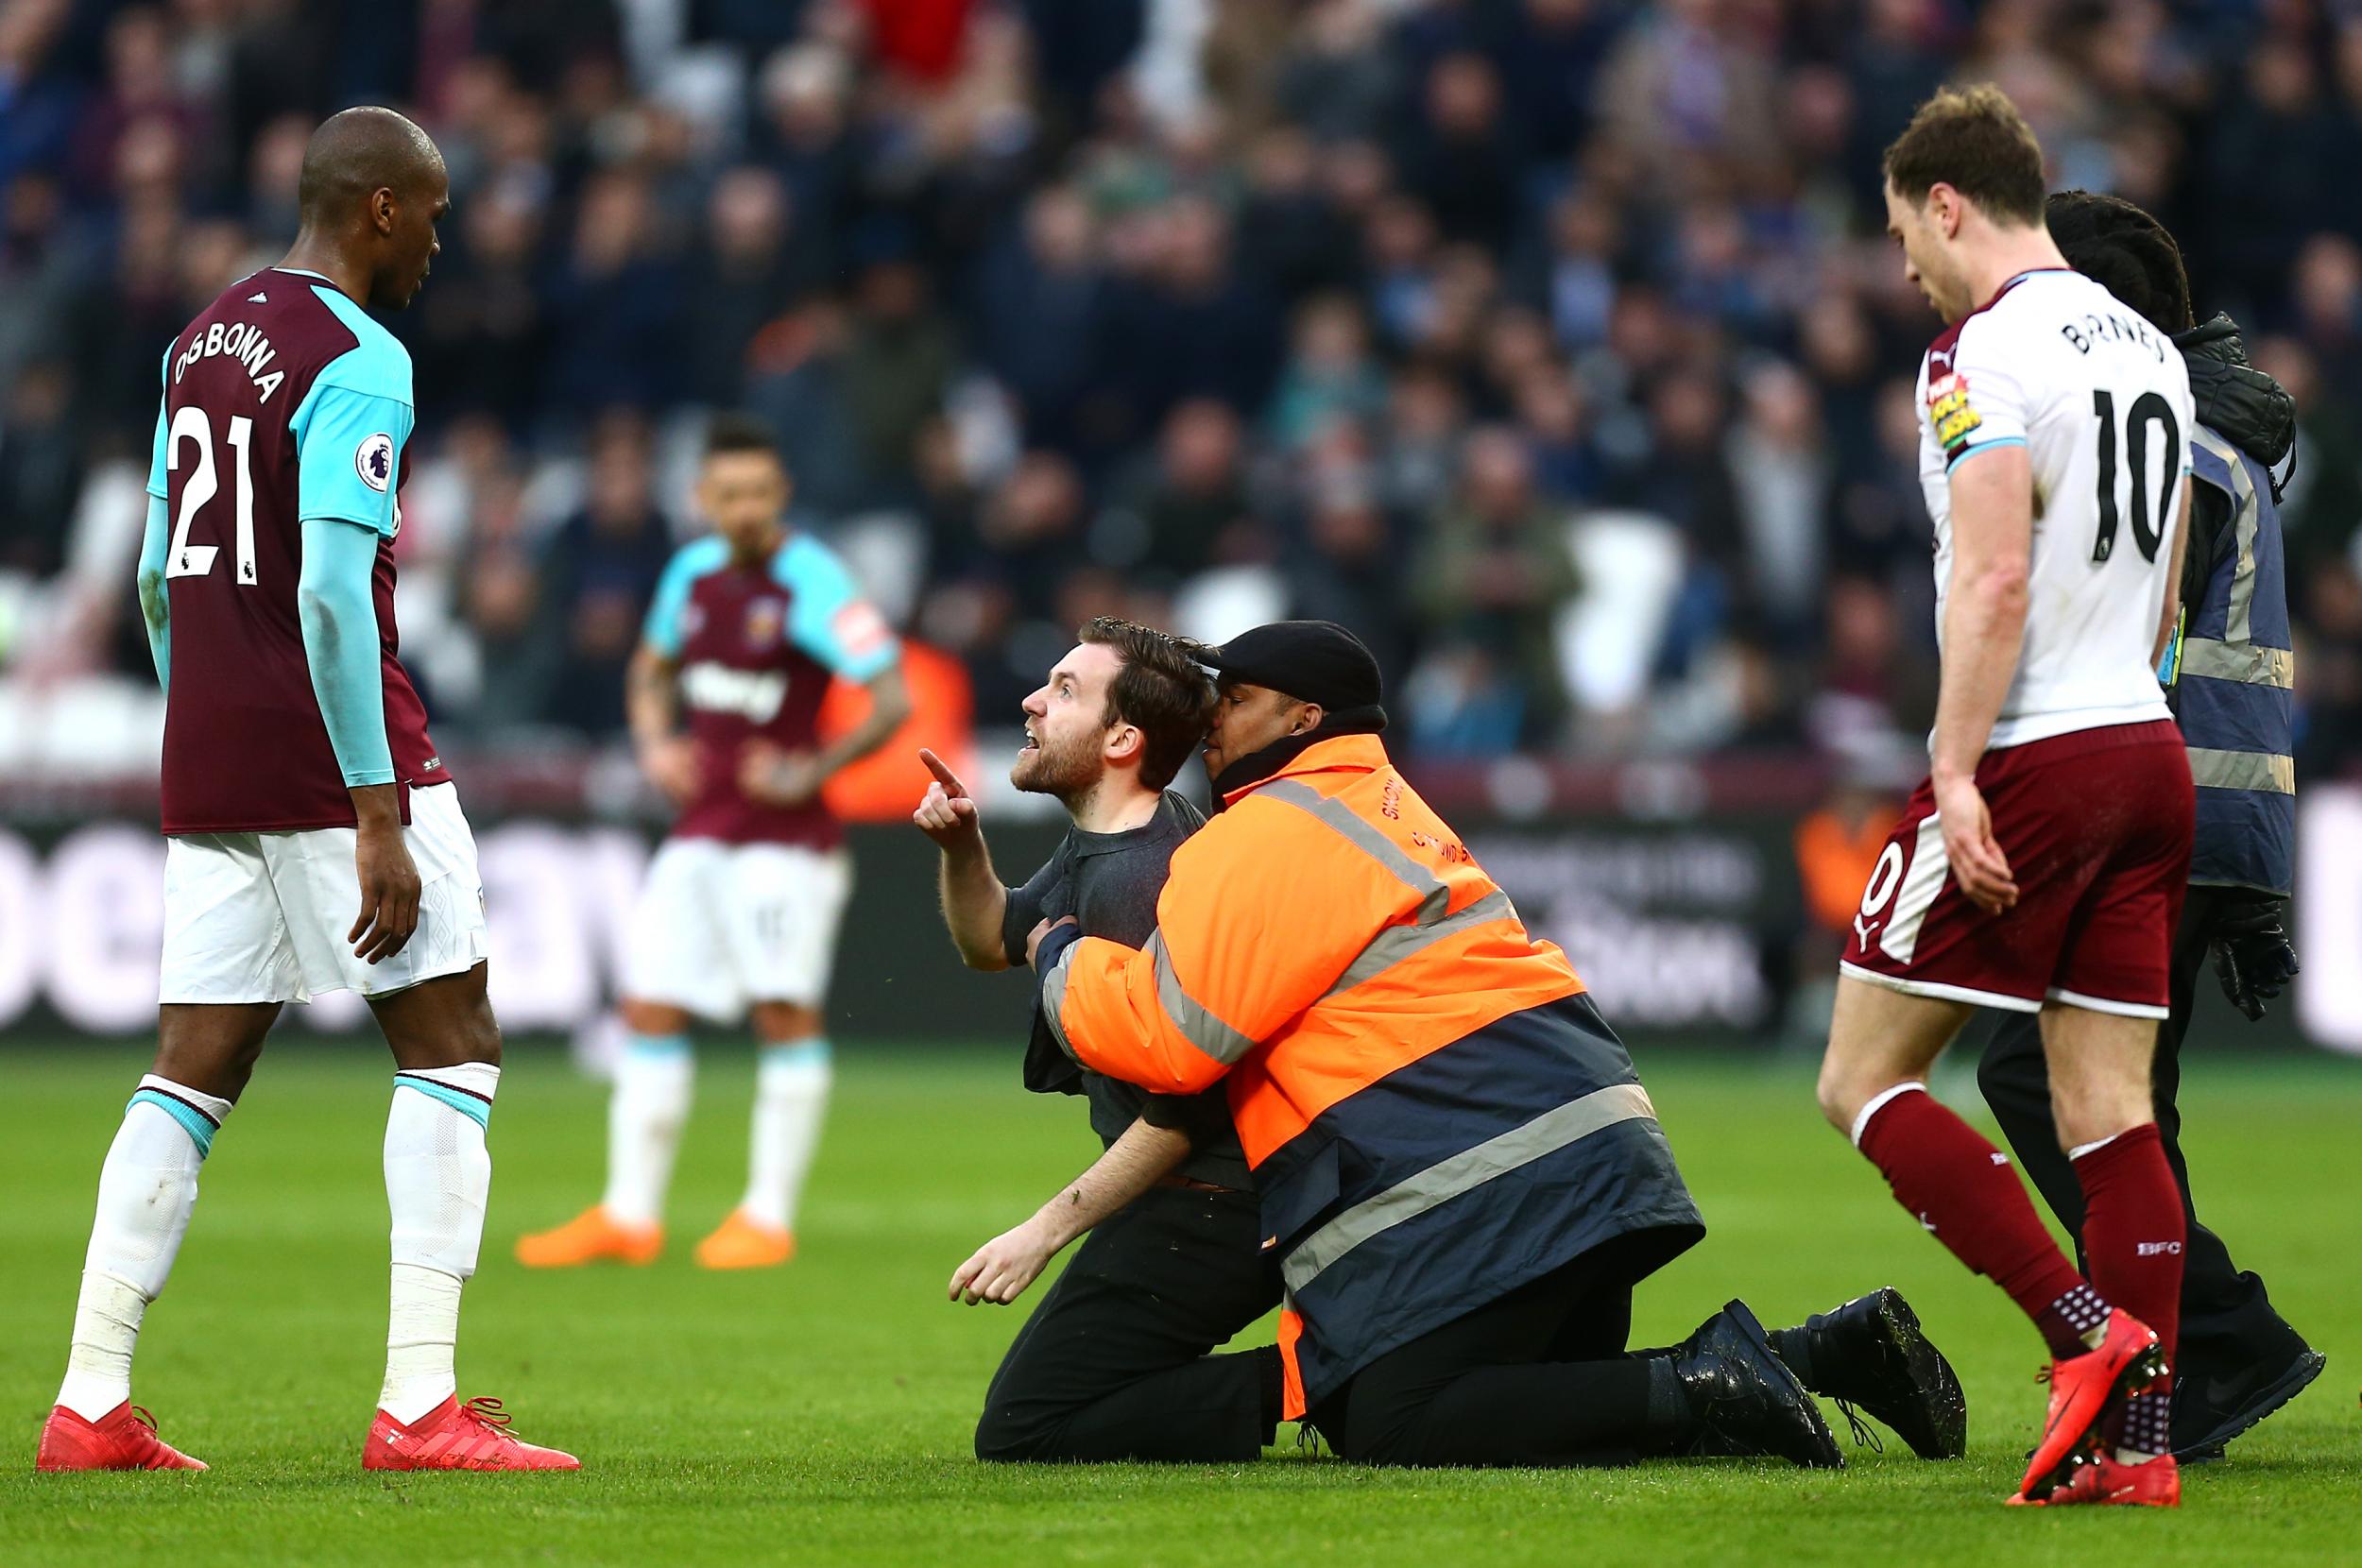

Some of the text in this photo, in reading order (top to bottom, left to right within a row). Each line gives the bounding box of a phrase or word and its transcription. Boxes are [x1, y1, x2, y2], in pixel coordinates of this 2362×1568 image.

[175, 322, 284, 404] OGBONNA
[2061, 313, 2165, 363] BRNES
[165, 406, 257, 585] 21
[2093, 389, 2180, 564] 10
[2137, 1241, 2182, 1256] BFC
